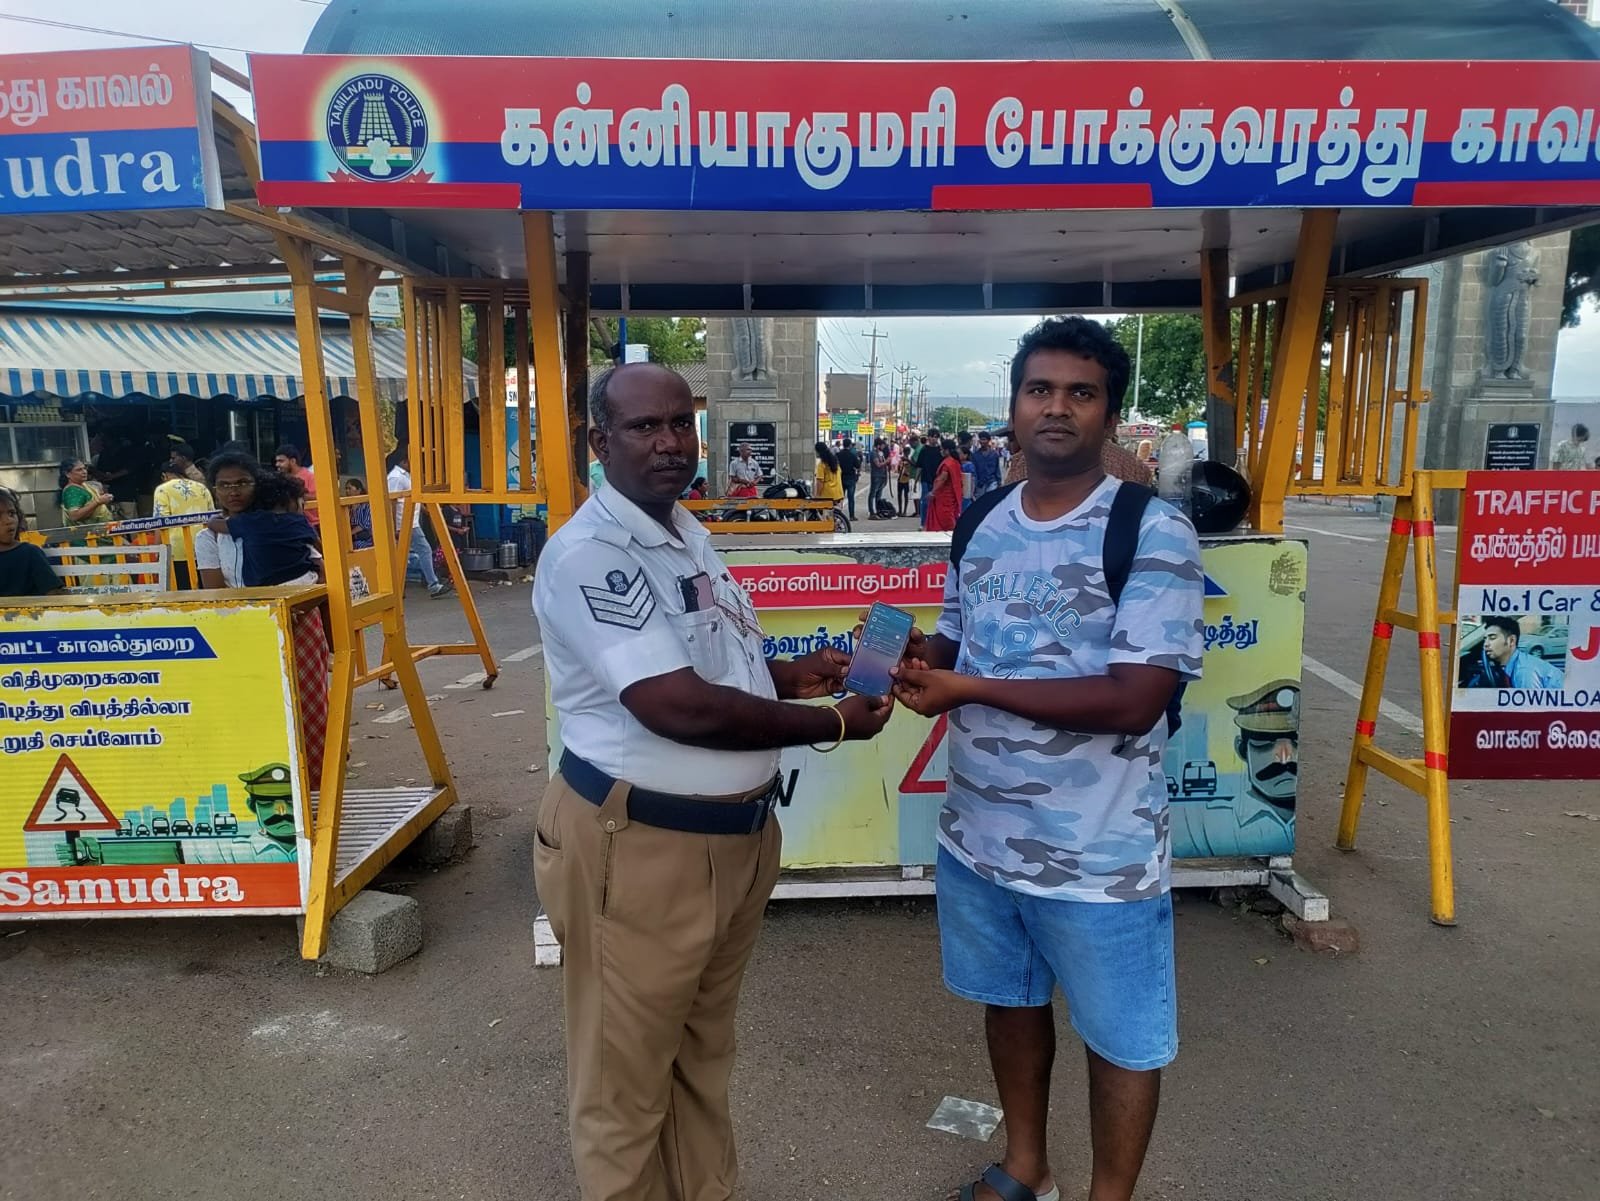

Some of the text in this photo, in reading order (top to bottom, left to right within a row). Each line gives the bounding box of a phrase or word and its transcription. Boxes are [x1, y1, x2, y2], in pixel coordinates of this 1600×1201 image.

[56, 63, 173, 110] காவல்
[330, 79, 424, 128] TAMILNADU POLICE
[501, 82, 1600, 197] கன்னியாகுமரி போக்குவரத்து காவ
[0, 137, 181, 199] udra
[1474, 490, 1584, 515] TRAFFIC
[740, 569, 919, 595] கன்னியாகுமரி
[1482, 589, 1530, 612] No.1
[1538, 589, 1582, 612] Car
[57, 633, 195, 657] காவல்துறை
[1, 670, 161, 690] விதிமுறைகளை
[70, 697, 191, 720] விபத்தில்லா
[0, 728, 162, 754] றுதி செய்வோம்
[1476, 729, 1541, 749] வாகன
[0, 869, 244, 905] Samudra
